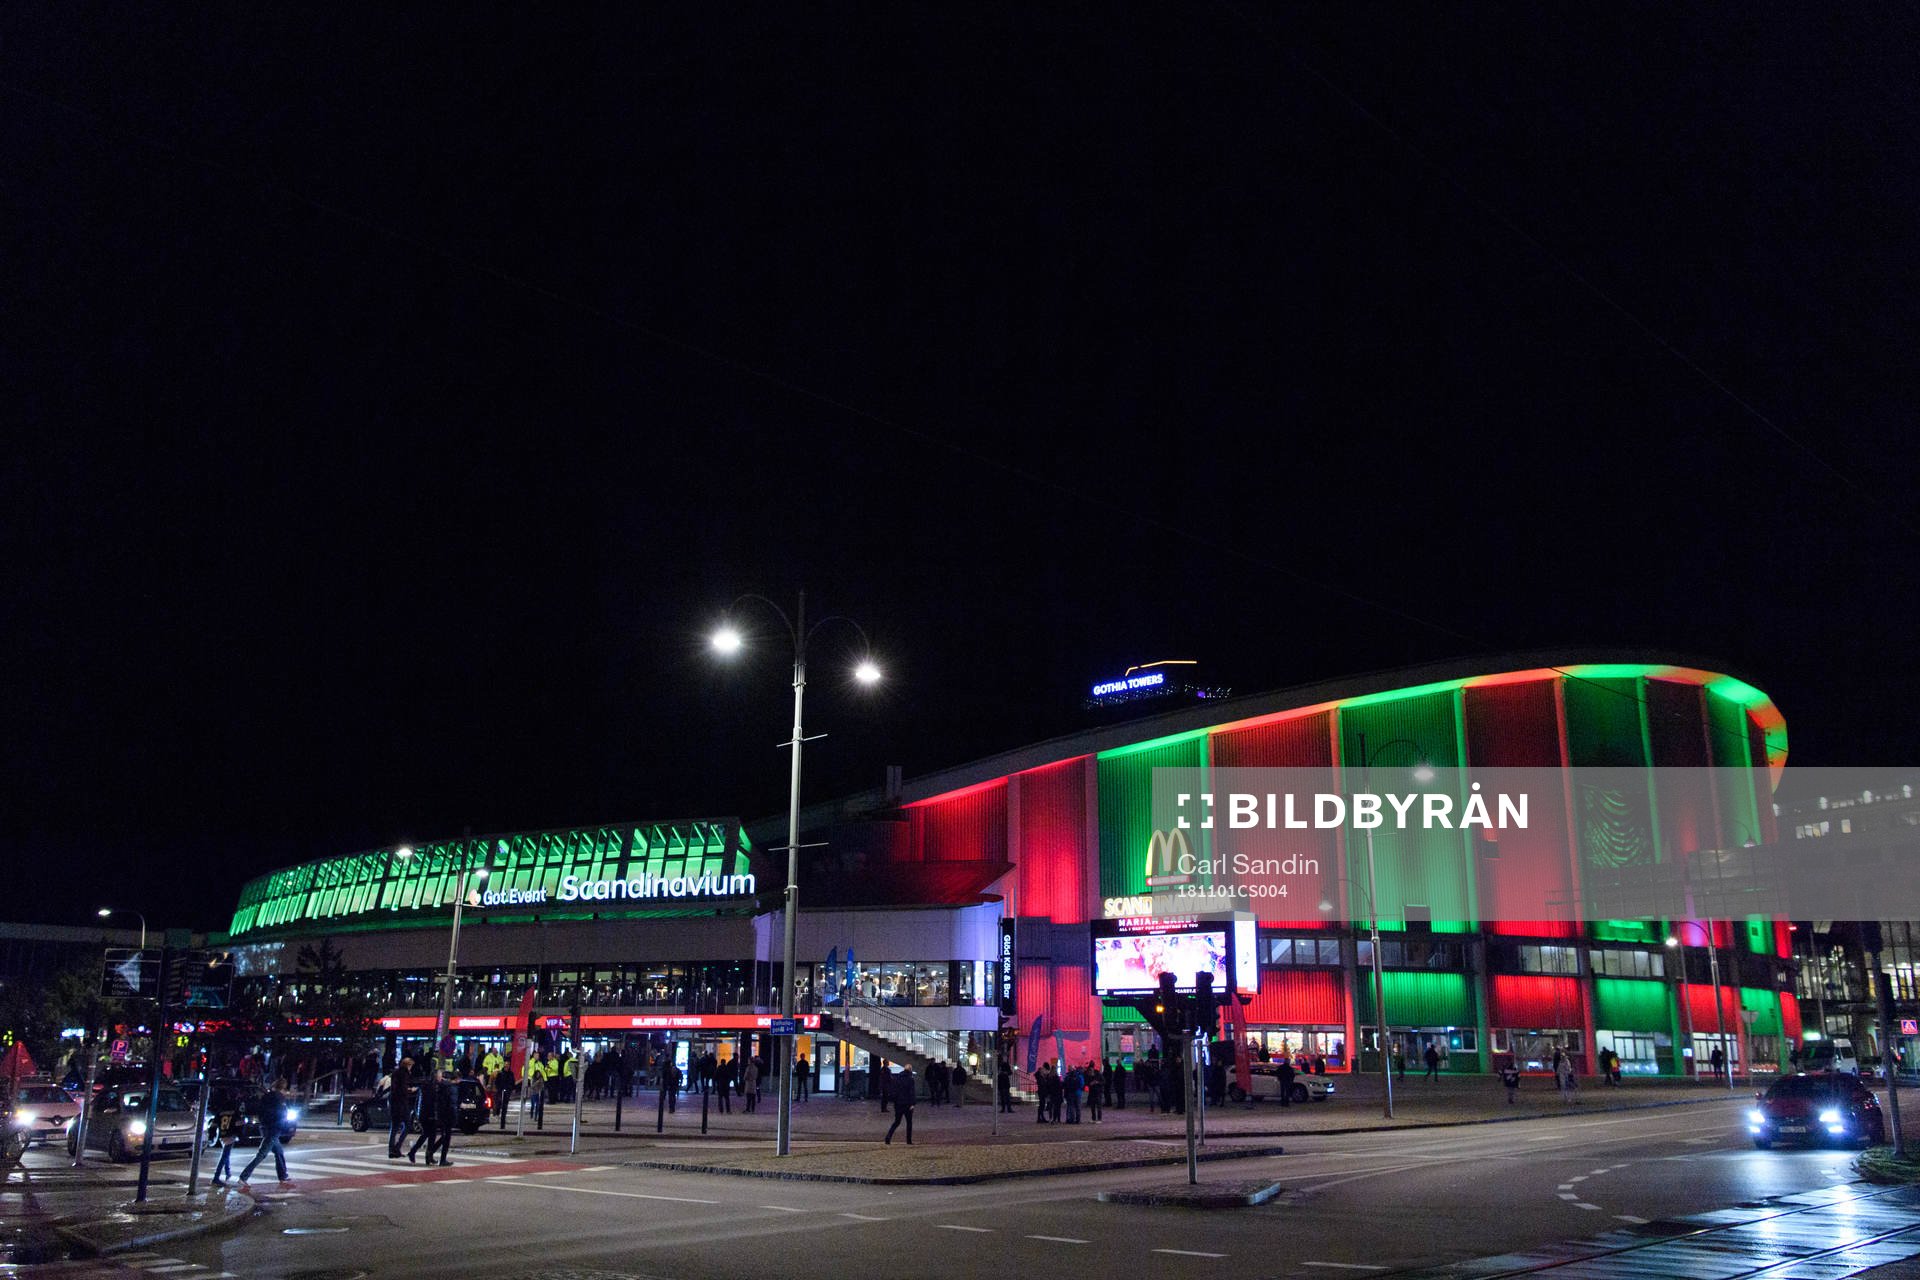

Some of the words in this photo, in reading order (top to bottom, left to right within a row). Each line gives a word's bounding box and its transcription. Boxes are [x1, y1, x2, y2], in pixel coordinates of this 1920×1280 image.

[1093, 680, 1127, 695] GOTHIA
[1128, 674, 1163, 689] TOWERS
[561, 870, 755, 901] Scandinavium
[483, 890, 507, 906] Got
[509, 886, 547, 904] Event
[673, 1017, 702, 1026] TICKETS
